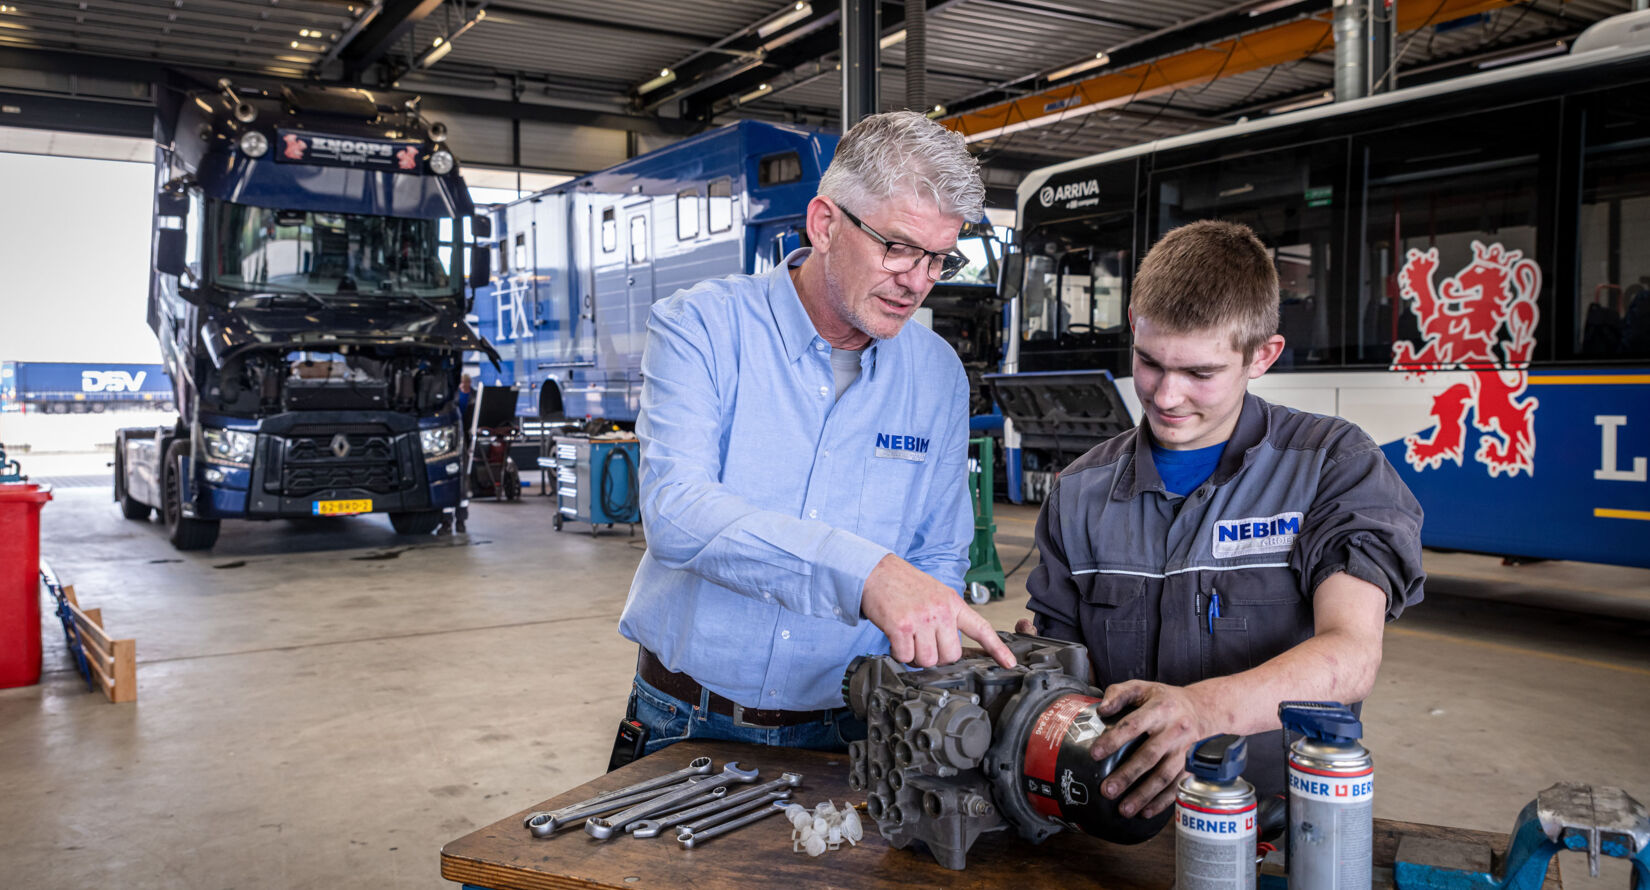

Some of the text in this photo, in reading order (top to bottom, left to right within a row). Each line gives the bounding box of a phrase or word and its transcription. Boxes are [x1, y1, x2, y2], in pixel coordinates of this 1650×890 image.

[311, 137, 393, 157] KNOOPS
[1054, 179, 1099, 201] ARRIVA
[82, 371, 147, 392] DSV
[876, 433, 930, 453] NEBIM
[1219, 517, 1300, 542] NEBIM
[1262, 535, 1296, 546] GROE
[1290, 774, 1374, 796] ERNER BER
[1182, 814, 1237, 833] BERNER
